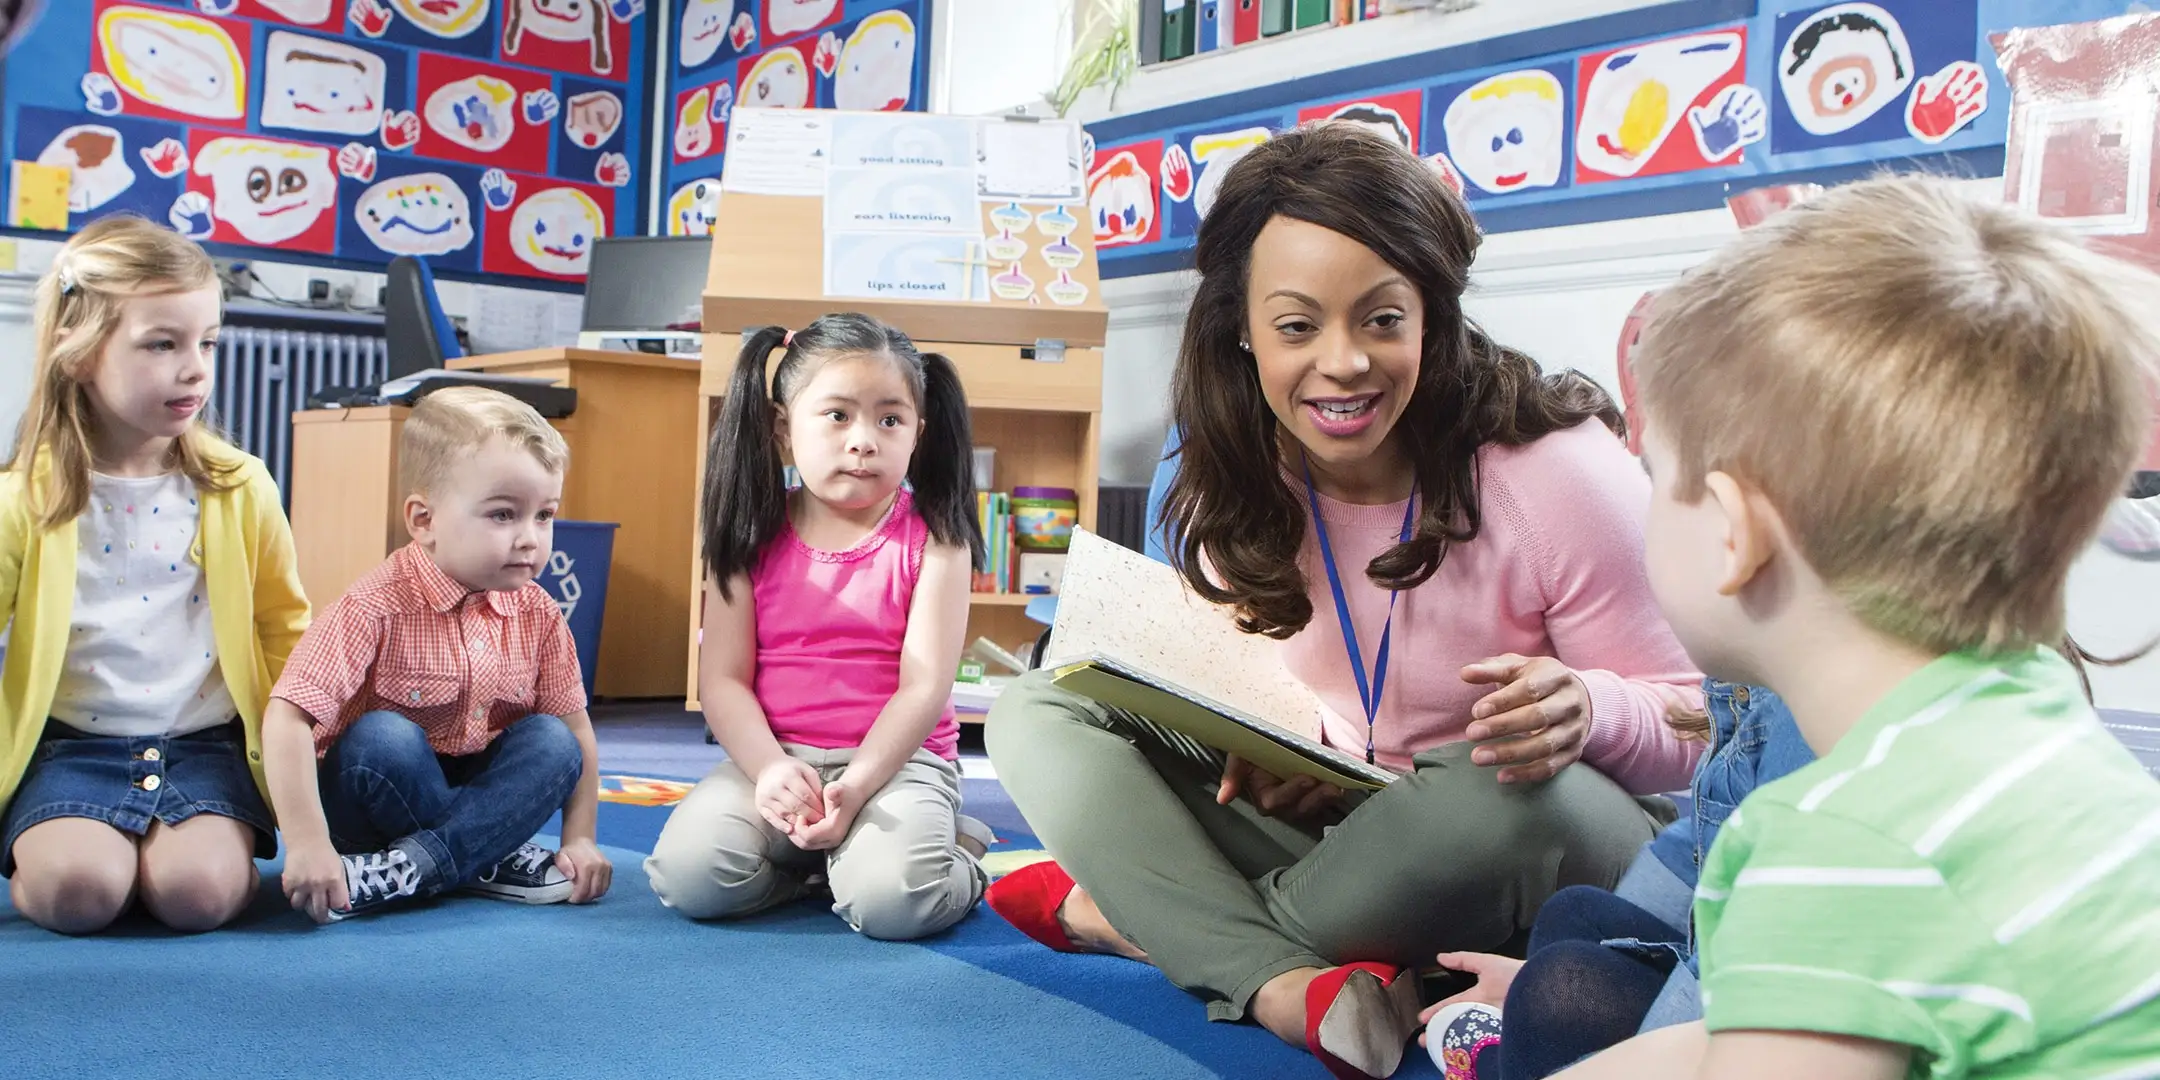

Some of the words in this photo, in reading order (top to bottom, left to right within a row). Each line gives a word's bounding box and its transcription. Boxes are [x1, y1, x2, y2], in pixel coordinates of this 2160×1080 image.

[859, 156, 893, 165] good
[899, 157, 943, 167] sitting
[889, 211, 951, 223] listening
[867, 280, 893, 292] lips
[899, 280, 946, 291] closed
